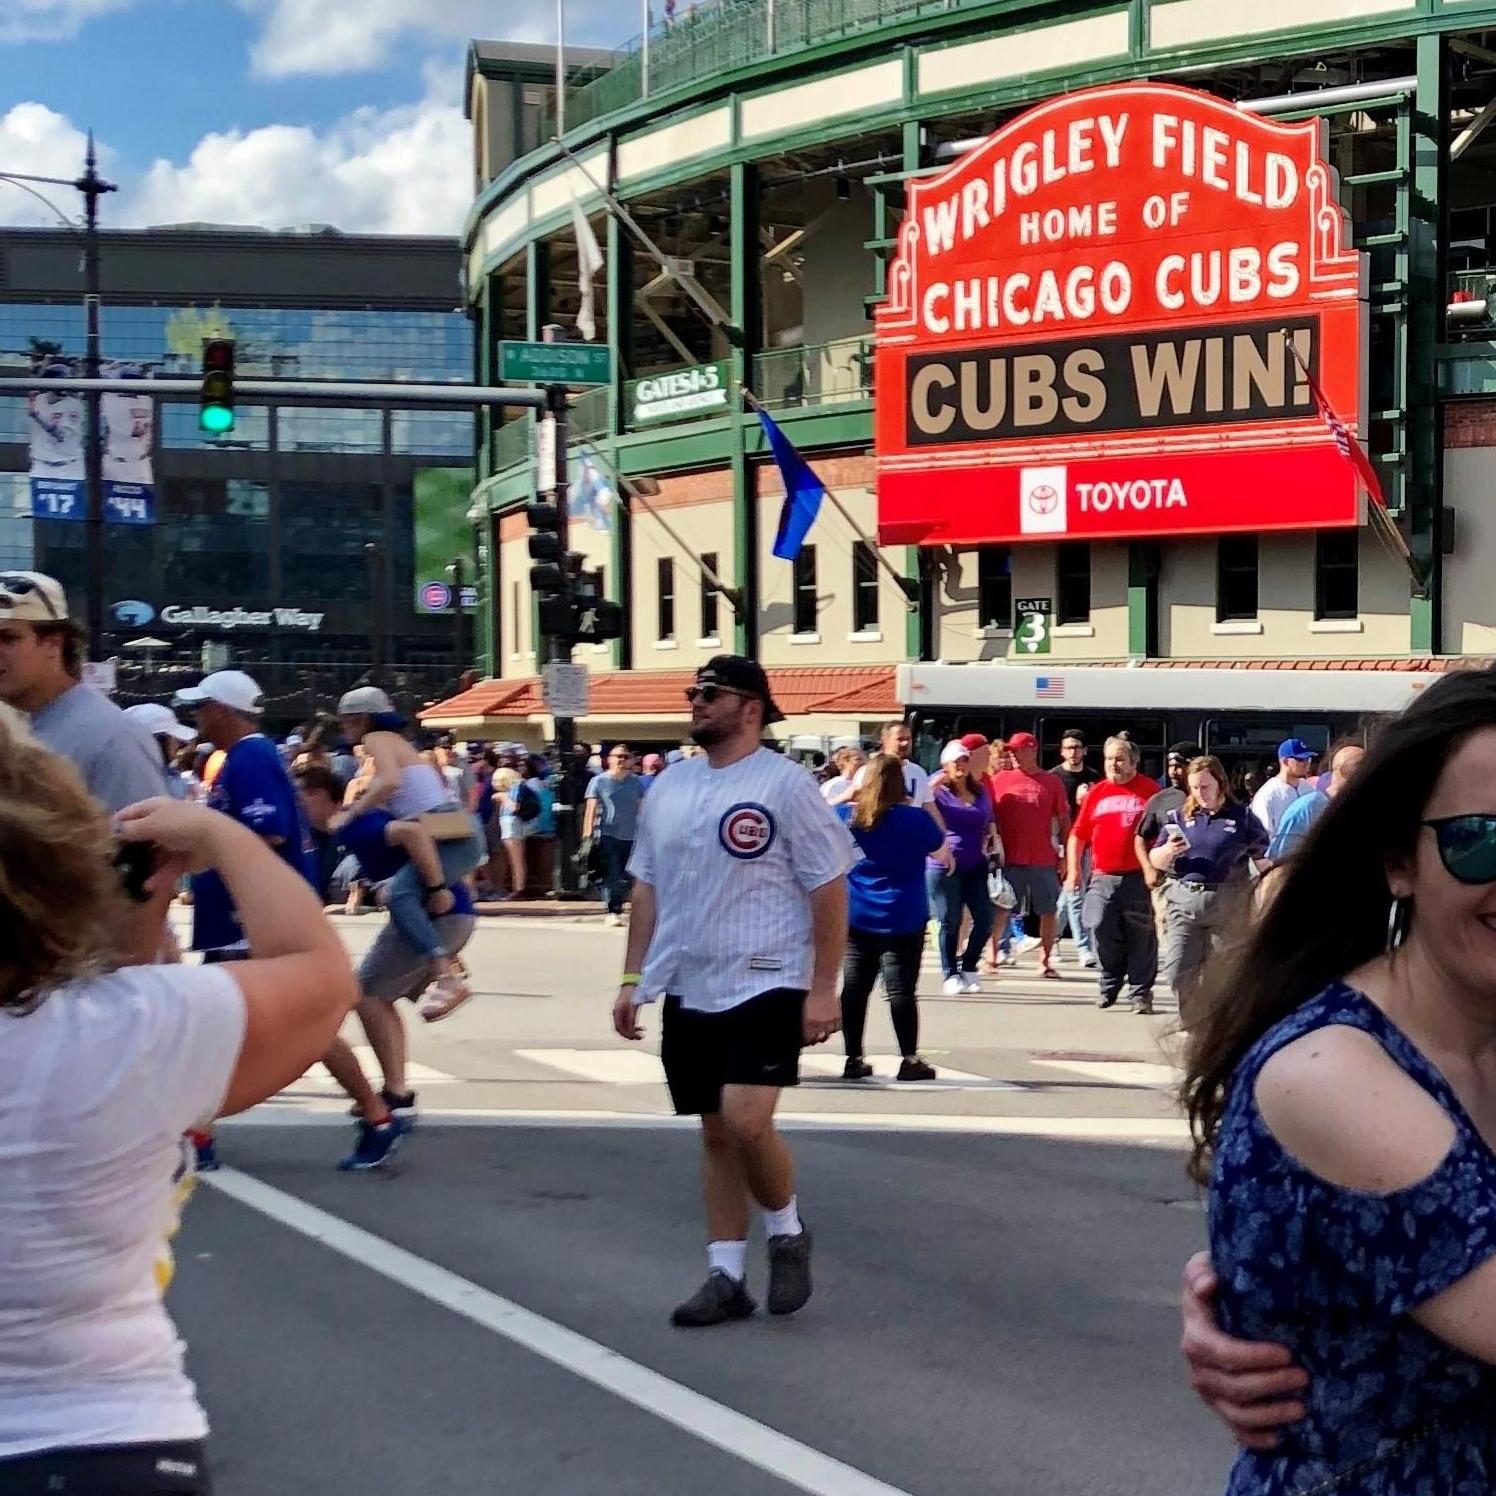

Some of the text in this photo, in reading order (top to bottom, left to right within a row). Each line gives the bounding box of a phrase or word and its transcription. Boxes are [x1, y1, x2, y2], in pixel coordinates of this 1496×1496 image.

[923, 112, 1299, 256] WRIGLEY FIELD
[1020, 191, 1190, 244] HOME OF
[922, 241, 1300, 333] CHICAGO CUBS
[636, 372, 690, 402] GATES
[911, 329, 1311, 434] CUBS WIN!
[1076, 478, 1187, 512] TOYOTA
[161, 605, 325, 631] Gallagher Way
[1017, 600, 1051, 611] GATE
[1020, 611, 1046, 643] 3
